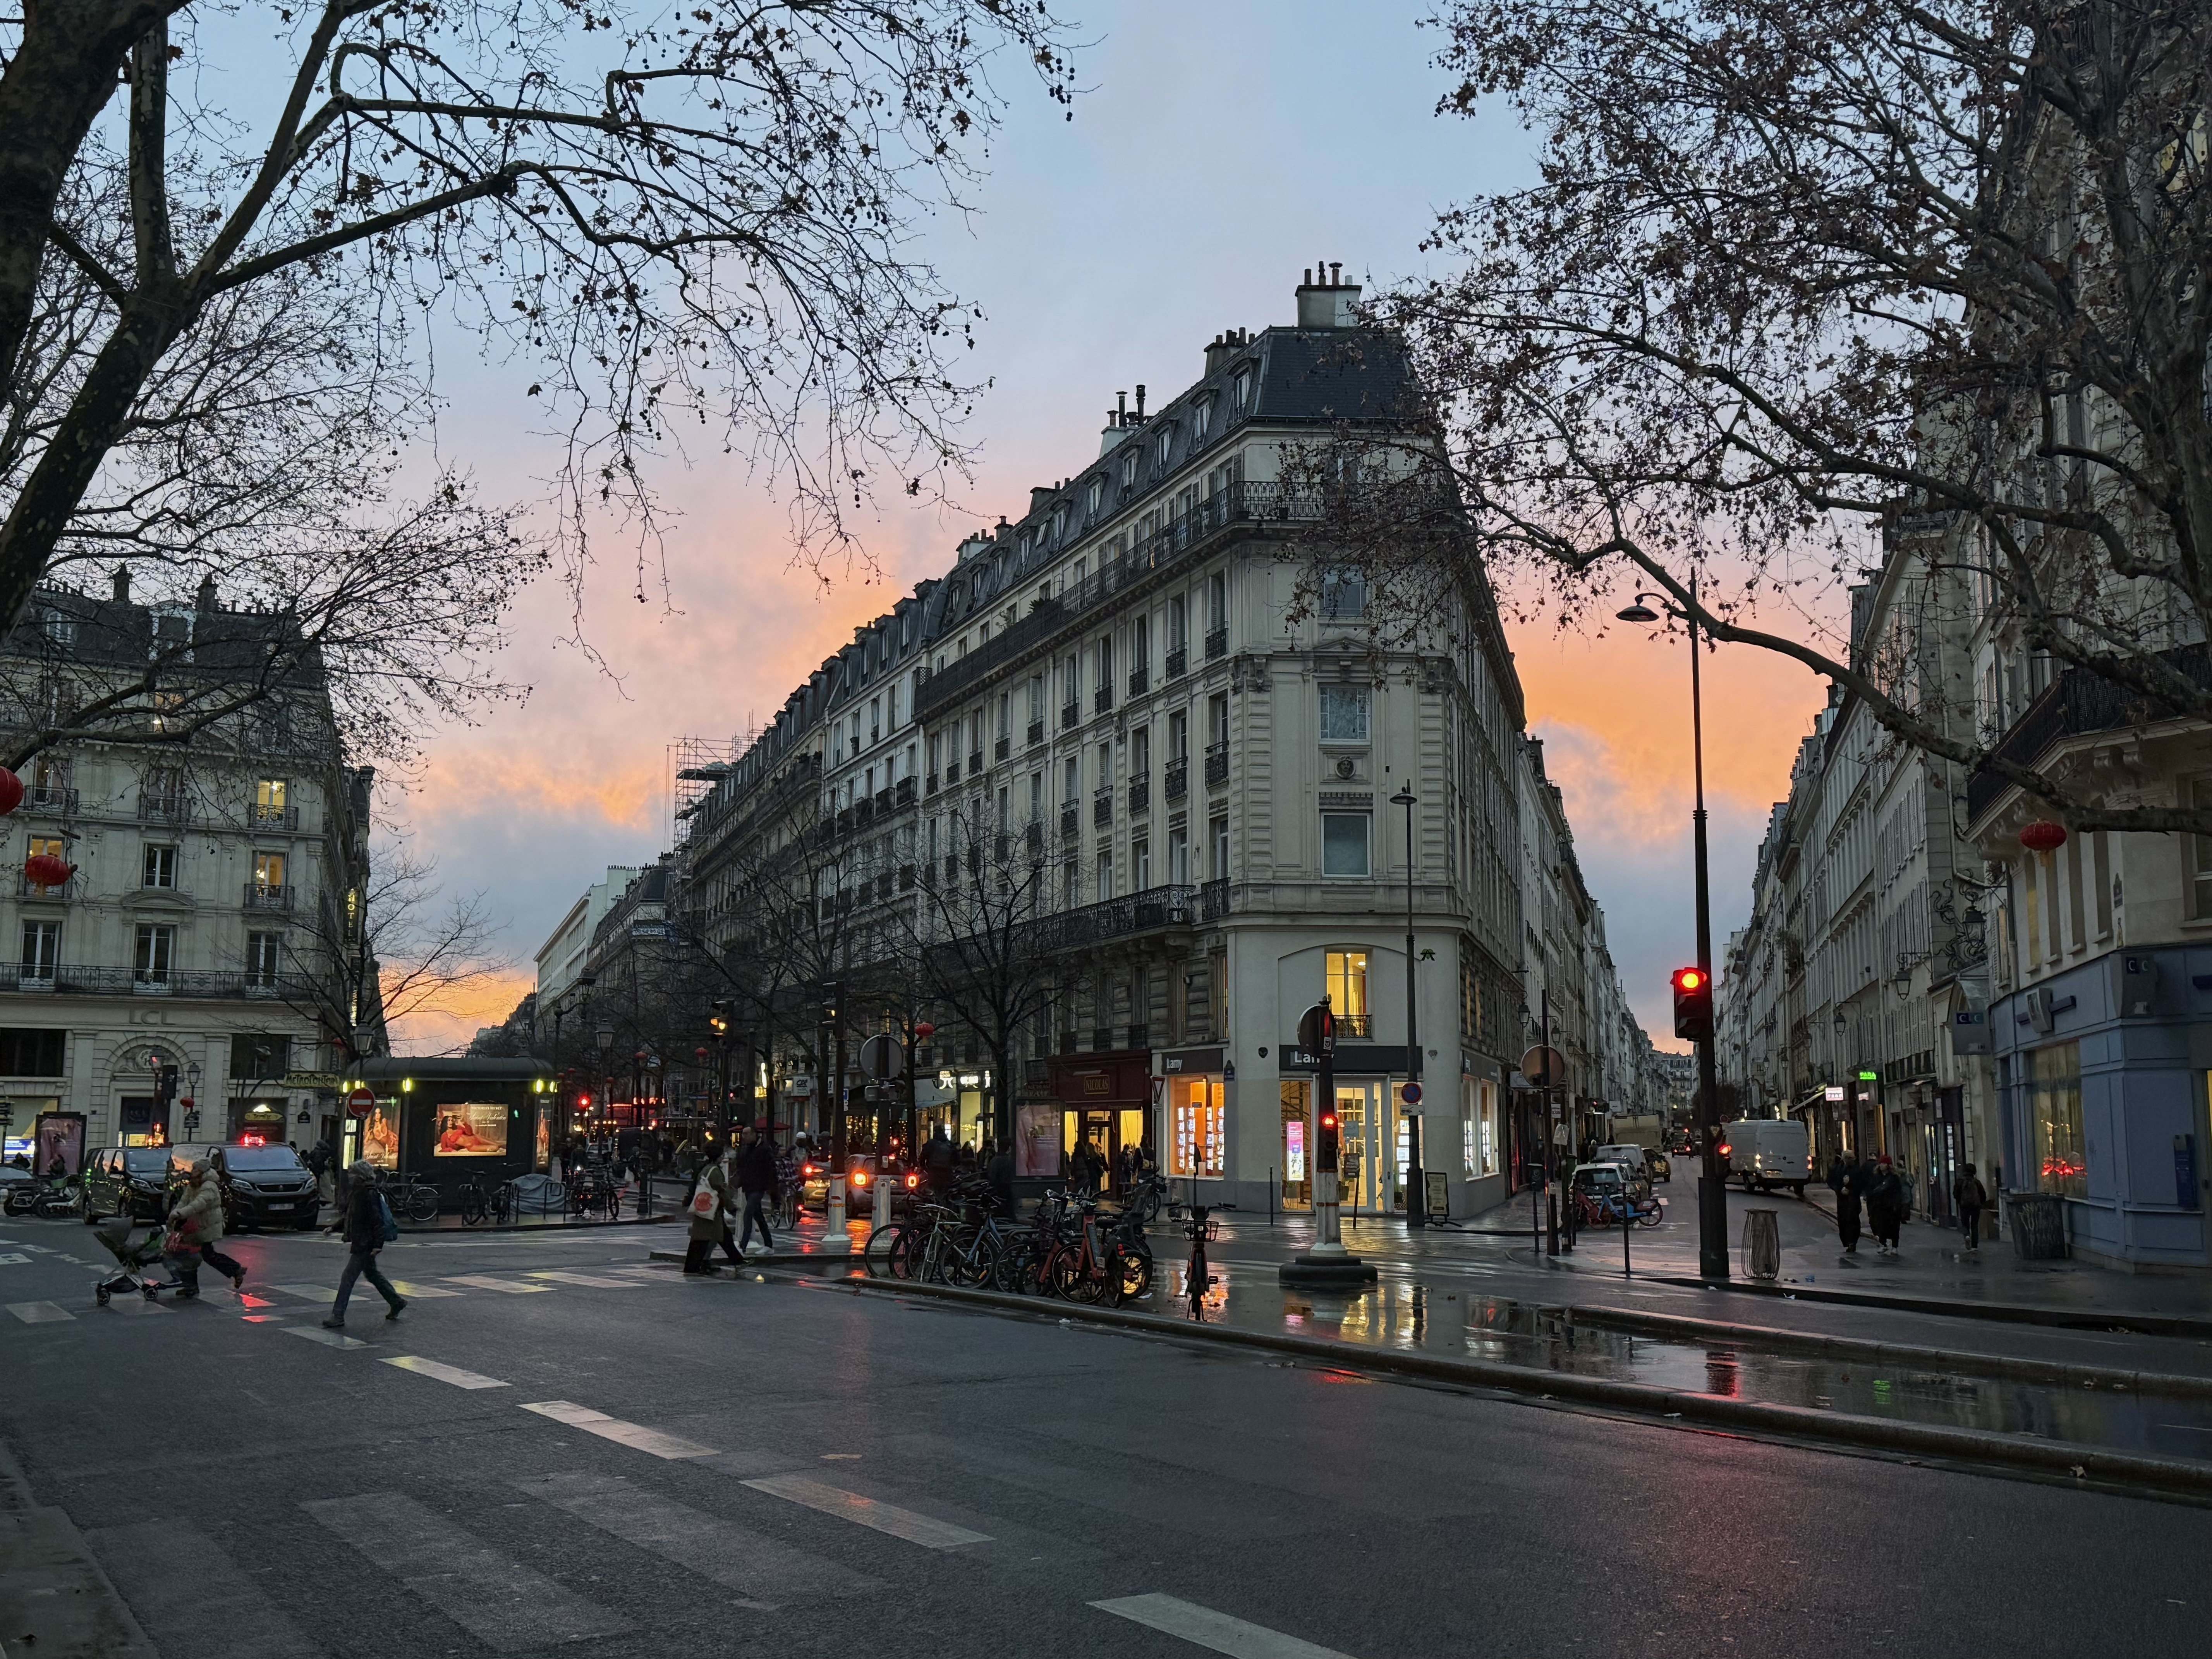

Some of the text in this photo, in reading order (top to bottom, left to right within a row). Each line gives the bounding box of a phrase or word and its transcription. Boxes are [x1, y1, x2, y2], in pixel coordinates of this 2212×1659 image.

[2128, 960, 2148, 971] CC
[129, 1009, 176, 1024] LCL
[1295, 1051, 1334, 1063] La
[1167, 1058, 1182, 1071] Lamy
[1086, 1079, 1108, 1091] NICOLAS
